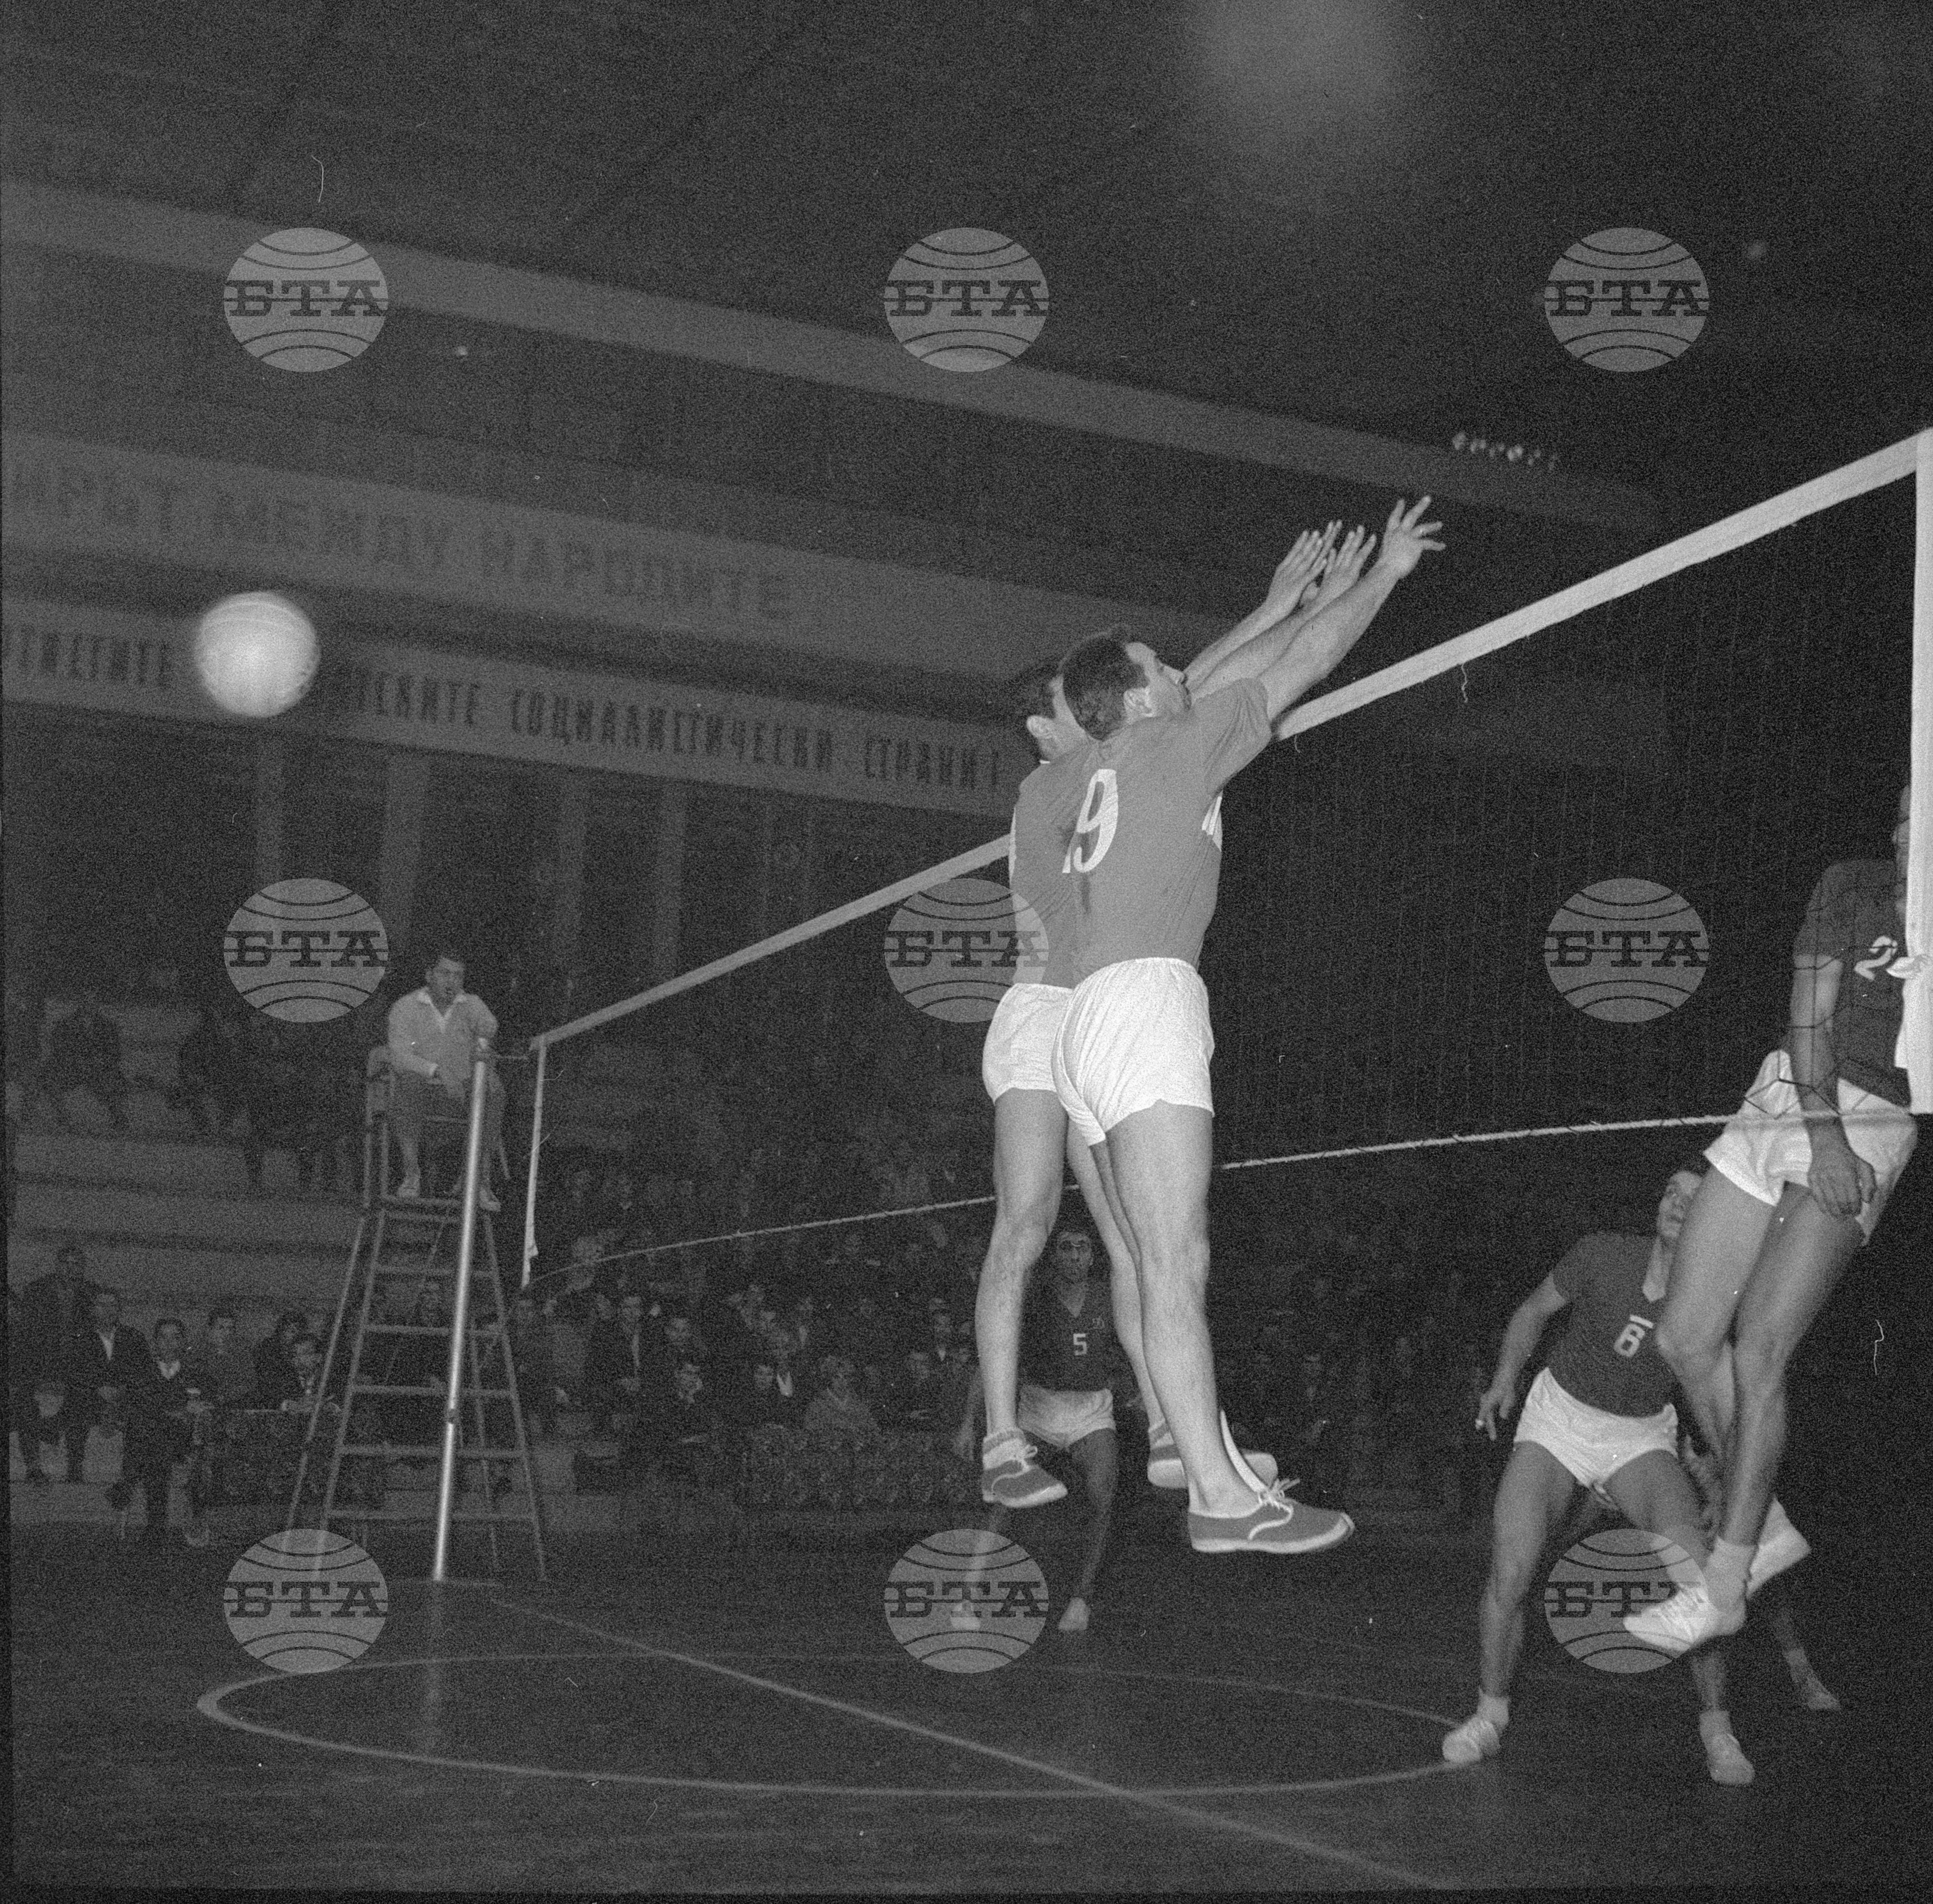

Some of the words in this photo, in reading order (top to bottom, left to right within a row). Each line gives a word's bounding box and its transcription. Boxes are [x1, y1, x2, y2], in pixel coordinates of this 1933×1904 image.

[212, 486, 450, 572] МЕЖДУ
[481, 529, 789, 620] НАРОДИТЕ
[1074, 768, 1118, 873] 9
[1073, 1333, 1087, 1356] 5
